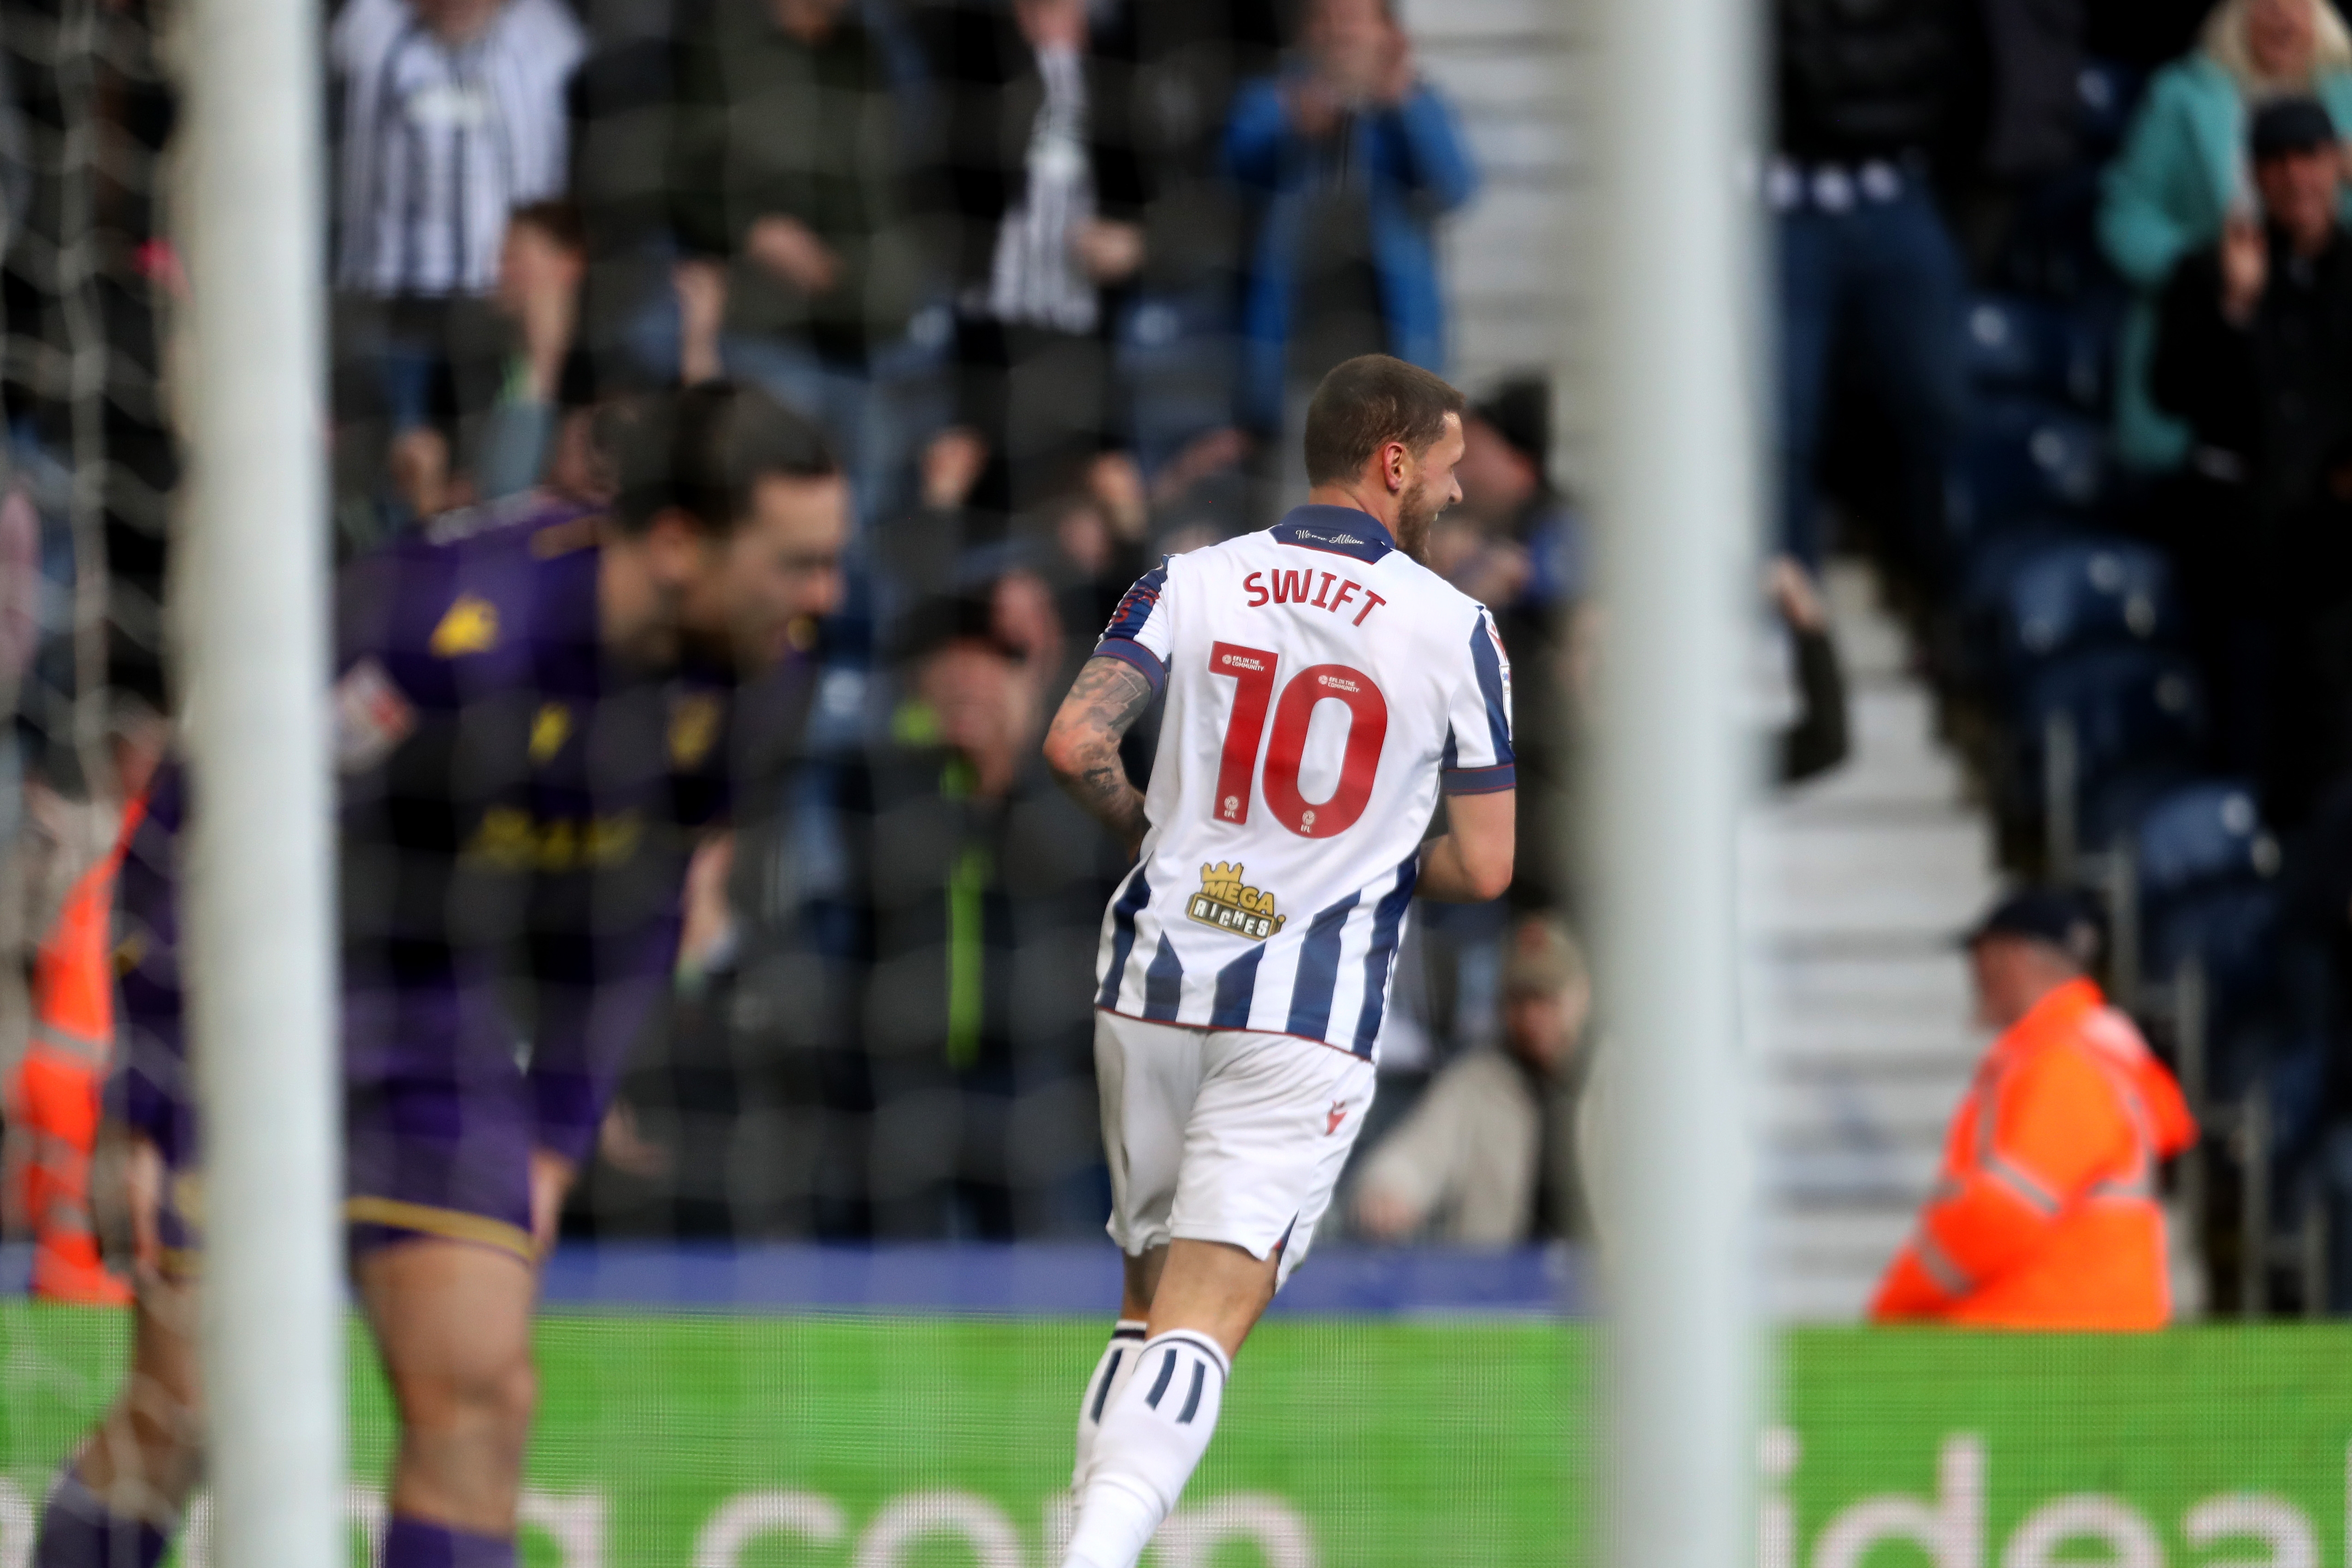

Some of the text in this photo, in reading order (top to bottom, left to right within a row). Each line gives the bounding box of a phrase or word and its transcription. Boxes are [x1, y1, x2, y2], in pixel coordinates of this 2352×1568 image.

[1295, 530, 1311, 539] We
[1329, 534, 1365, 544] Albion
[1243, 568, 1387, 627] SWIFT
[1232, 661, 1264, 671] COMMUNITY
[1328, 682, 1359, 692] COMMUNITY
[1208, 641, 1388, 839] 10
[1224, 810, 1236, 818] EFL
[1201, 881, 1274, 916] MEGA
[1193, 899, 1271, 936] RICHES
